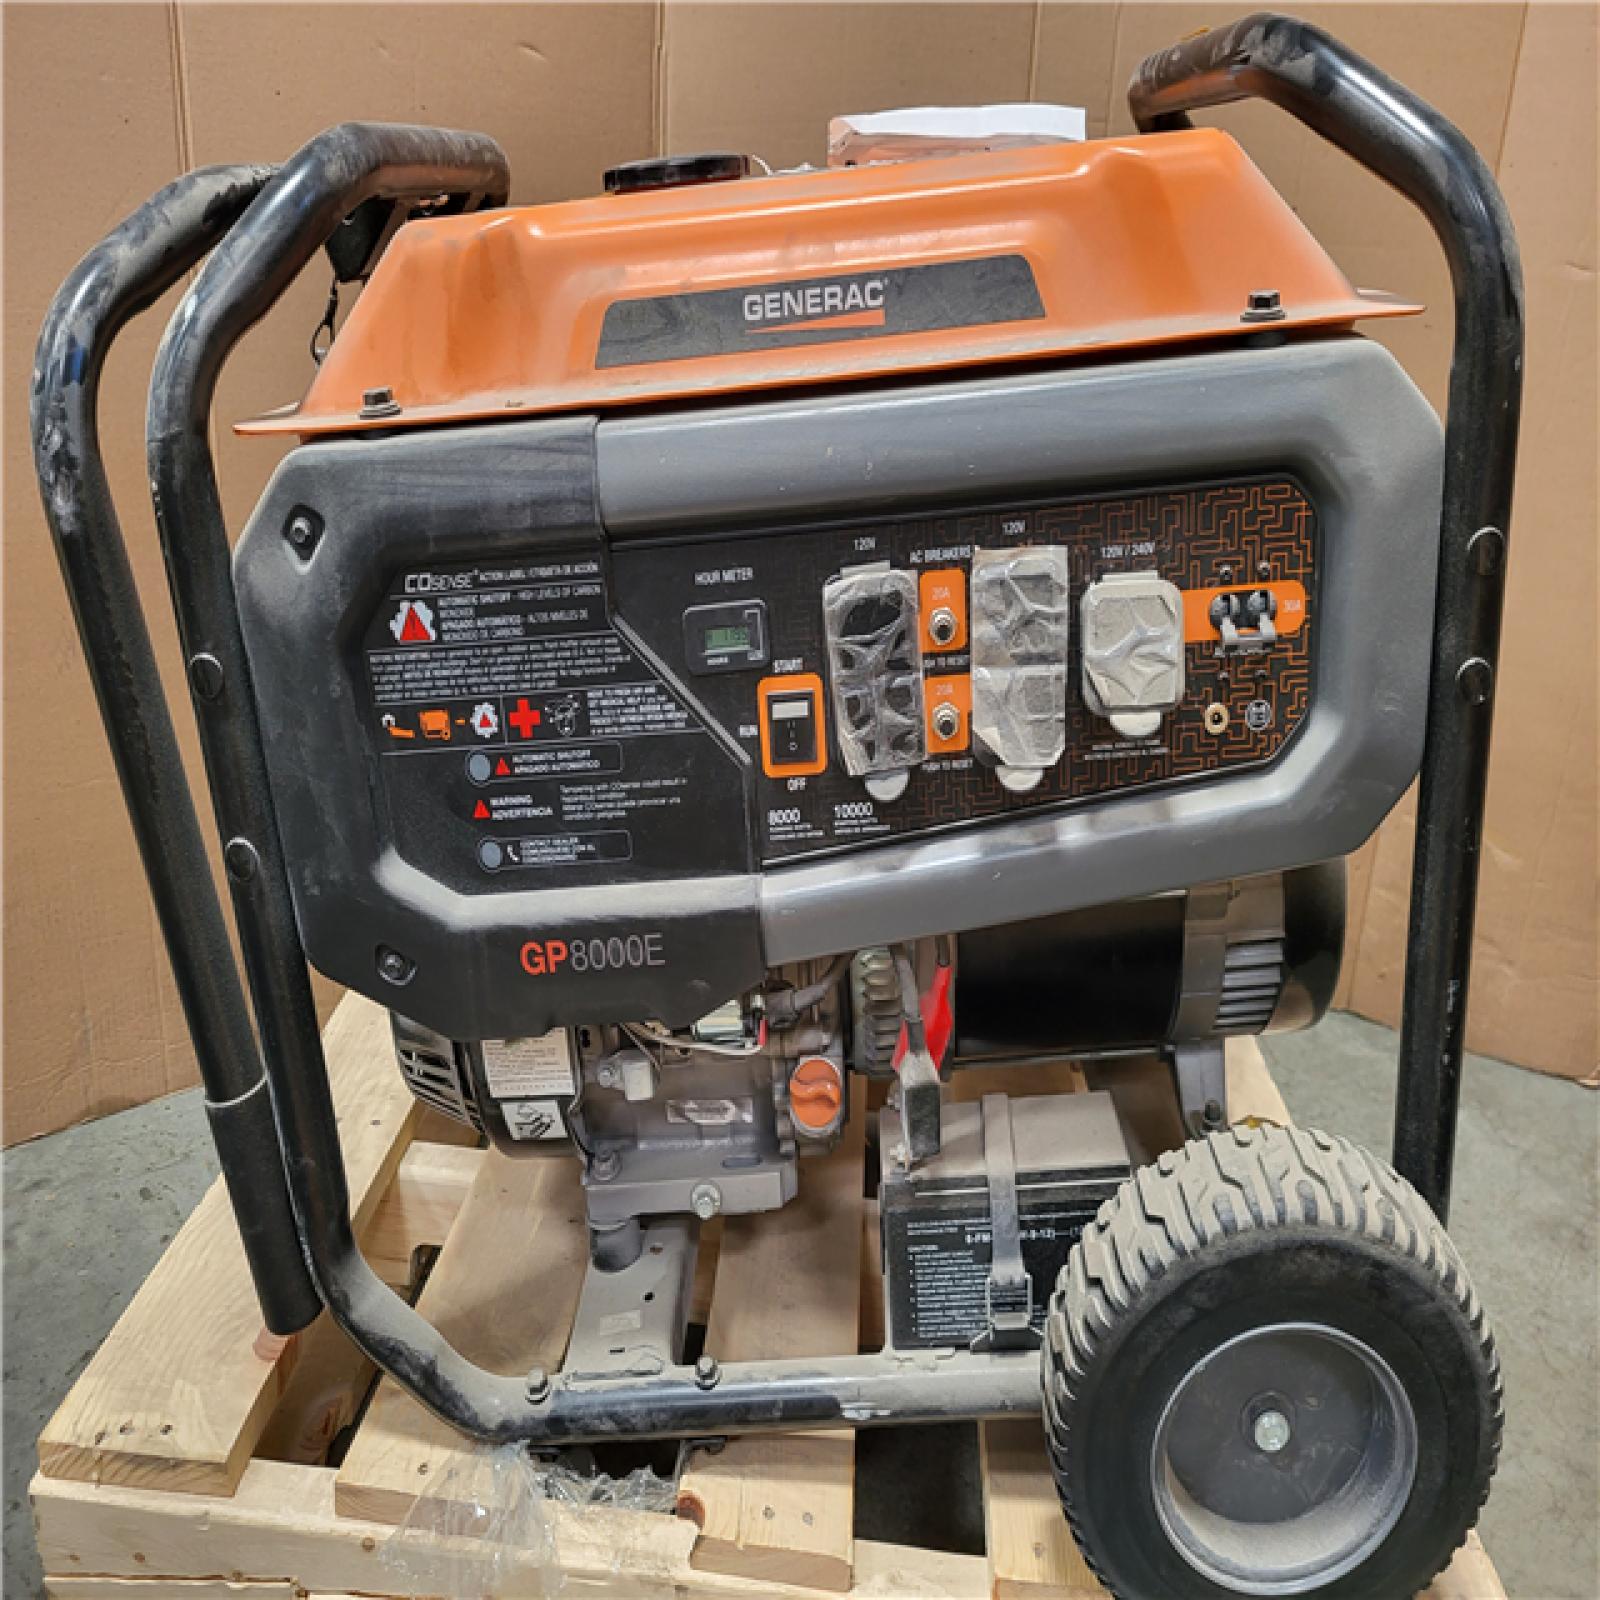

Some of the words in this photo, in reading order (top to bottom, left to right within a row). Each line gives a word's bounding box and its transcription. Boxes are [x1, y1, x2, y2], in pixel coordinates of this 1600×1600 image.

[744, 279, 884, 321] GENERAC
[1002, 520, 1025, 535] 120V
[854, 536, 876, 550] 120V
[694, 570, 721, 585] HOUR
[722, 567, 753, 582] METER
[774, 657, 803, 672] START
[787, 777, 806, 791] OFF
[768, 807, 801, 825] 8000
[834, 802, 873, 818] 10000
[520, 932, 666, 976] GP8000E
